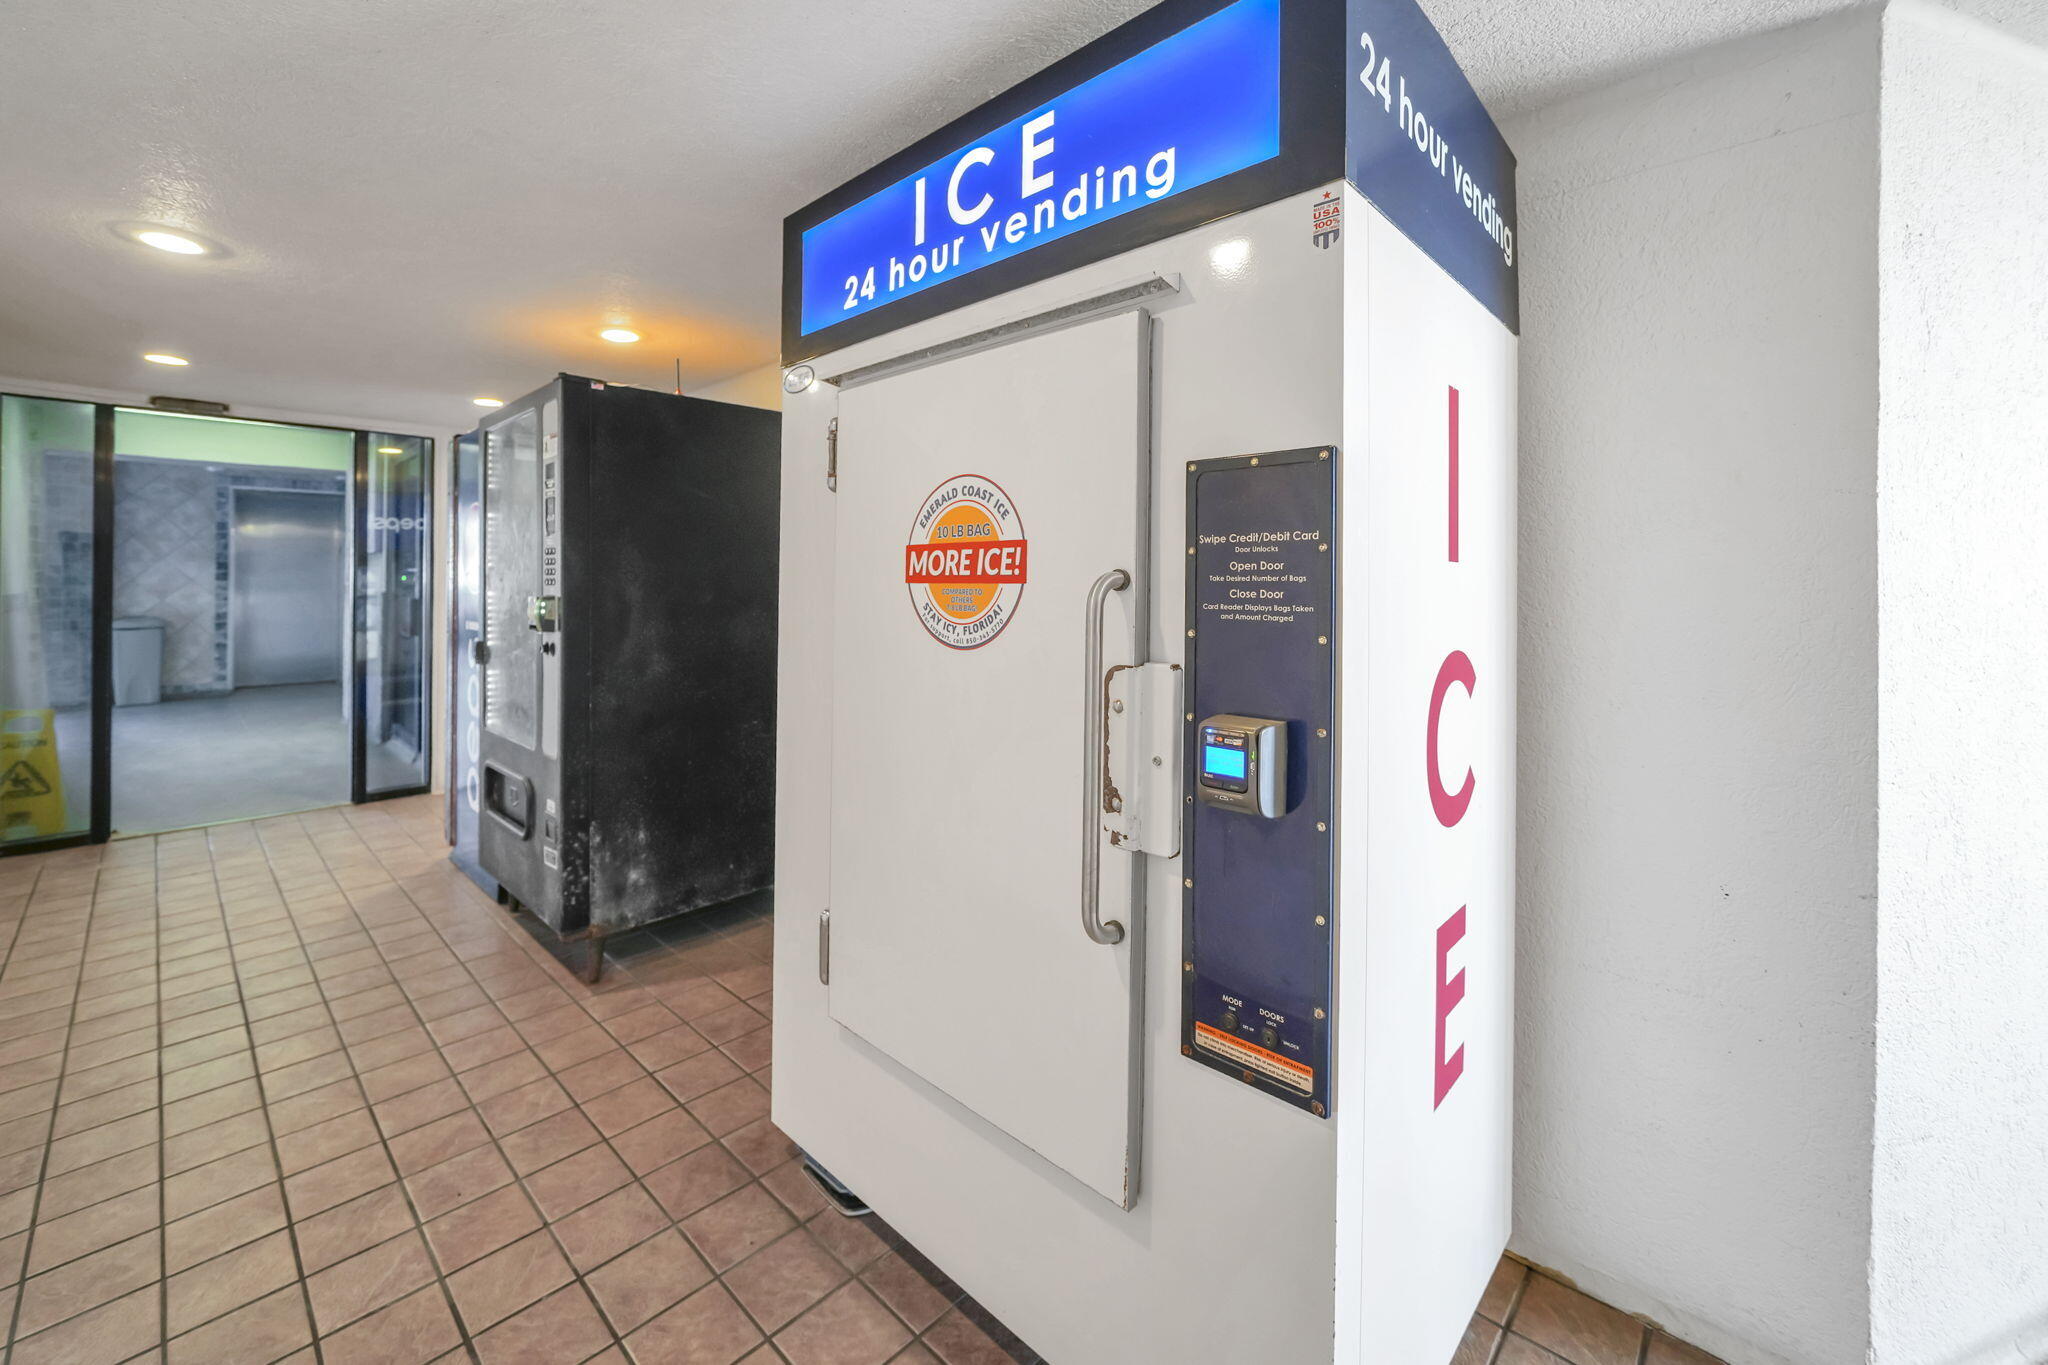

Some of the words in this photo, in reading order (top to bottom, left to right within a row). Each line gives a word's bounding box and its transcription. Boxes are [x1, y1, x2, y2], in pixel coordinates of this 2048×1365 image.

[1359, 31, 1391, 114] 24
[1399, 75, 1448, 178] hour
[1452, 154, 1513, 268] vending
[913, 109, 1055, 247] ICE
[1313, 206, 1340, 219] USA
[843, 270, 876, 311] 24
[888, 236, 963, 293] hour
[980, 146, 1177, 253] vending
[1313, 217, 1340, 230] 100%
[919, 487, 958, 529] EMERALD
[961, 485, 994, 504] COAST
[993, 498, 1010, 521] ICE
[937, 526, 949, 539] 10
[951, 525, 964, 537] LB
[967, 523, 991, 537] BAG
[1199, 534, 1227, 546] Swipe
[1229, 531, 1291, 543] Credit/Debit
[1293, 530, 1320, 541] Card
[1252, 545, 1279, 553] Unlocks
[909, 548, 973, 576] MORE
[976, 546, 1022, 576] ICE!
[1229, 561, 1257, 572] Open
[1260, 561, 1284, 570] Door
[1280, 574, 1288, 582] of
[1289, 575, 1307, 583] Bags
[1229, 589, 1257, 599] Close
[1260, 590, 1284, 599] Door
[1220, 603, 1244, 611] Reader
[1244, 604, 1272, 612] Displays
[1273, 605, 1291, 613] Bags
[923, 602, 942, 626] STAY
[942, 621, 960, 637] ICY,
[962, 603, 1004, 636] FLORIDA!
[1262, 614, 1294, 623] Charged
[1222, 994, 1243, 1008] MODE
[1259, 1008, 1285, 1023] DOORS
